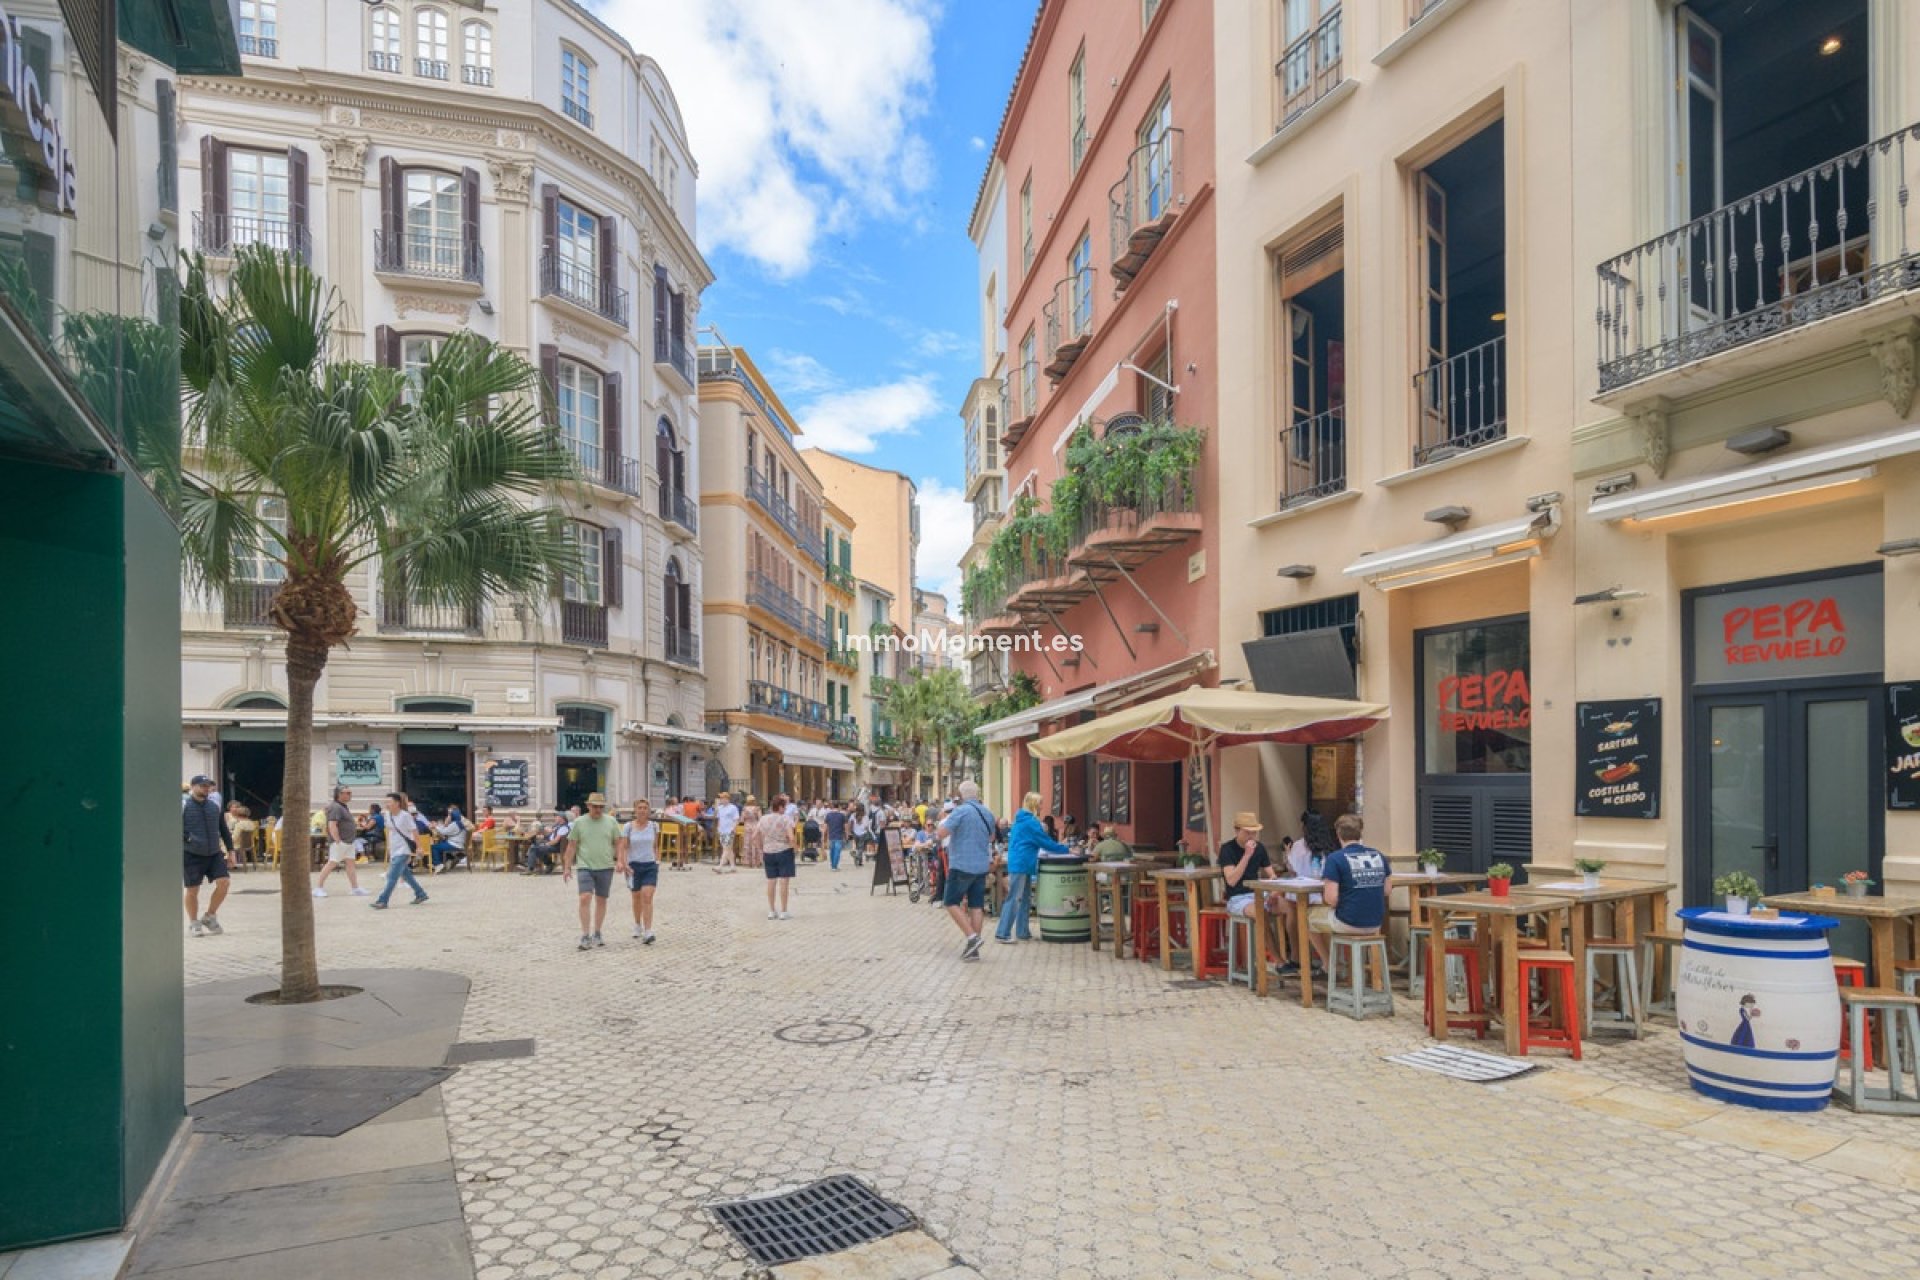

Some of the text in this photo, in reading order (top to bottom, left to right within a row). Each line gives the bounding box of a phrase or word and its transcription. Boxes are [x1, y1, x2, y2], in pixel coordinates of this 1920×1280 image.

[1723, 598, 1845, 643] PEPA
[1725, 636, 1846, 664] REVUELO
[1438, 670, 1530, 711] PEPA
[565, 734, 602, 750] TABERNA
[342, 759, 376, 772] TABERNA
[1588, 782, 1639, 798] COSTILLAR
[1614, 791, 1646, 805] CERDO
